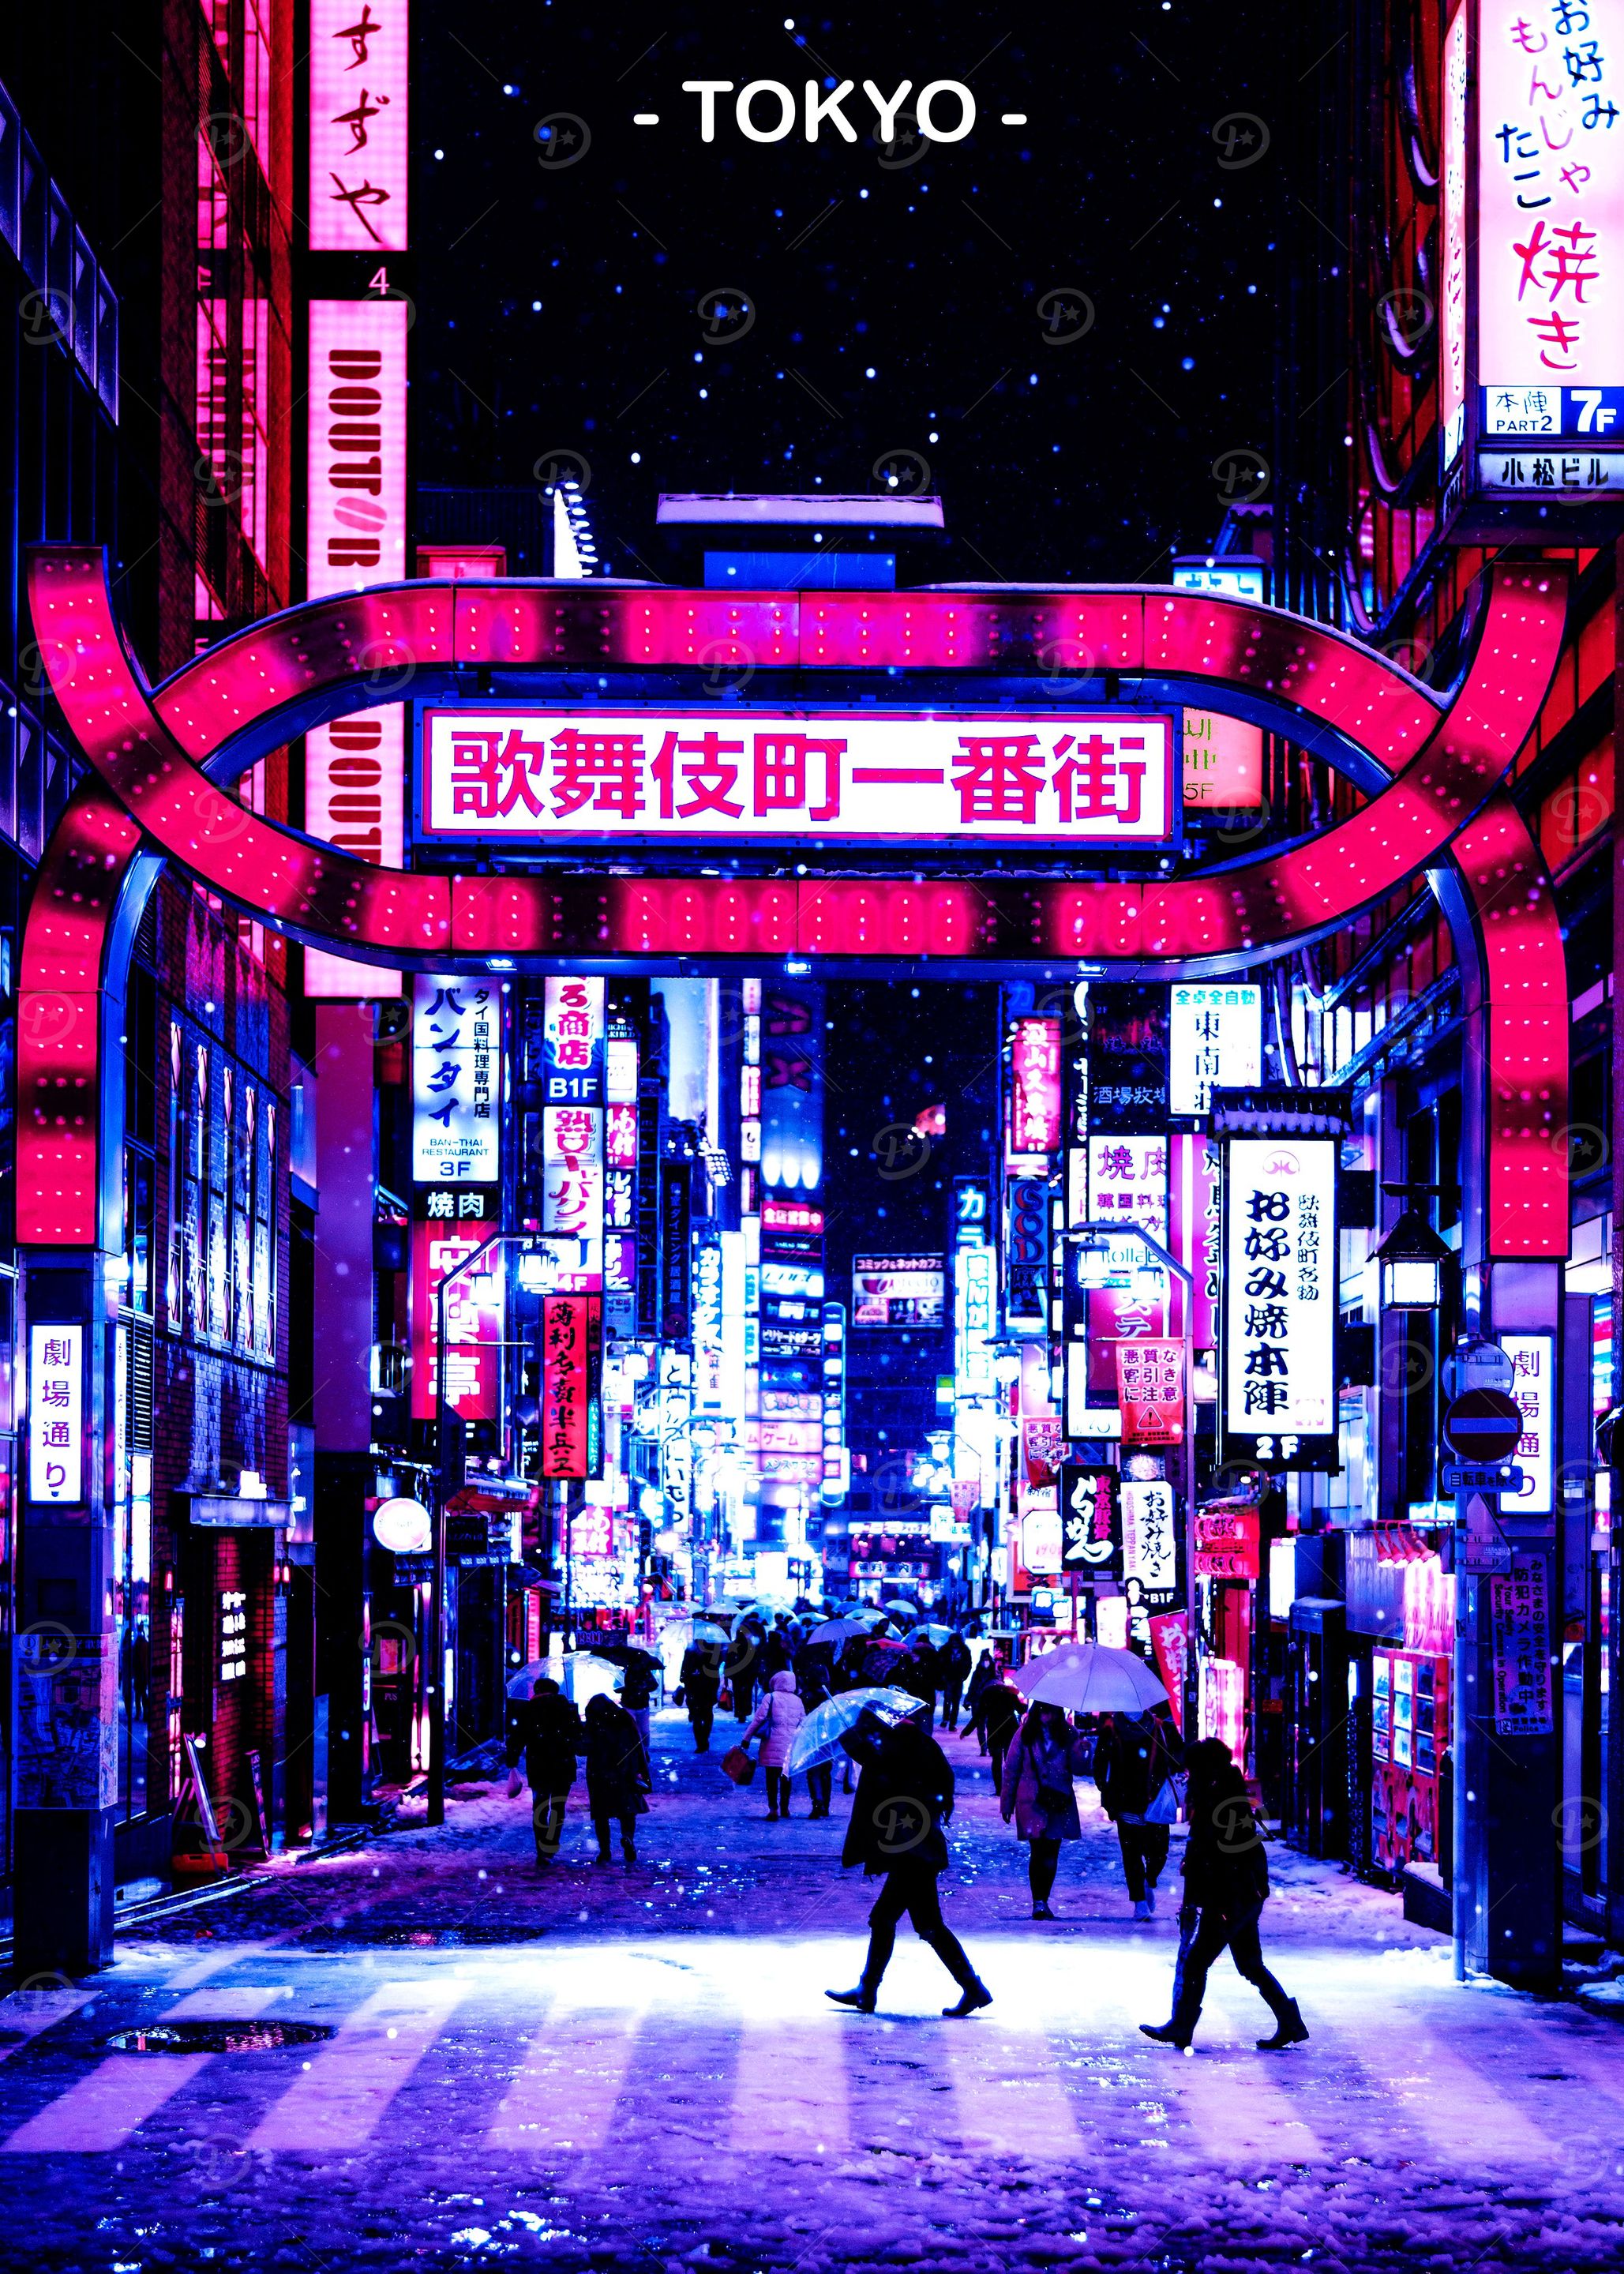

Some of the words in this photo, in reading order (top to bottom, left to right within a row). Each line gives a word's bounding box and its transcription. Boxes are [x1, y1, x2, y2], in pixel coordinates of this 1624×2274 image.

[1552, 0, 1619, 129] お好み
[1510, 17, 1591, 193] もんじゃ
[330, 4, 390, 243] すずや
[1495, 124, 1551, 208] たこ
[369, 267, 390, 295] 4
[1512, 220, 1600, 370] 焼き
[1495, 391, 1548, 415] 本陣
[1570, 389, 1617, 433] 7F
[1496, 415, 1553, 432] PART2
[328, 349, 388, 567] DOUTOR
[1502, 458, 1609, 486] 小松ビル
[451, 727, 1146, 825] 歌舞伎町一番街
[1176, 990, 1255, 1005] 全卓全自動
[559, 978, 590, 1066] ろ商店
[424, 988, 467, 1128] バンタイ
[473, 988, 490, 1119] タイ国料理専門店
[549, 1078, 598, 1098] B1F
[422, 1147, 490, 1157] RESTAURANT
[429, 1138, 483, 1147] BAN-THAI
[439, 1161, 471, 1177] 3F
[427, 1191, 485, 1218] 焼肉
[1296, 1194, 1320, 1300] 歌舞伎町名物
[1243, 1189, 1291, 1415] お好み焼本陣
[1123, 1349, 1176, 1364] 悪質な
[1123, 1368, 1176, 1383] 客引き
[1124, 1387, 1177, 1402] に注意
[43, 1339, 72, 1487] 劇場通り
[1255, 1435, 1300, 1460] 2F
[1450, 1472, 1517, 1488] 自転車を除く
[1140, 1490, 1172, 1578] お好み焼き
[1150, 1593, 1174, 1604] B1F
